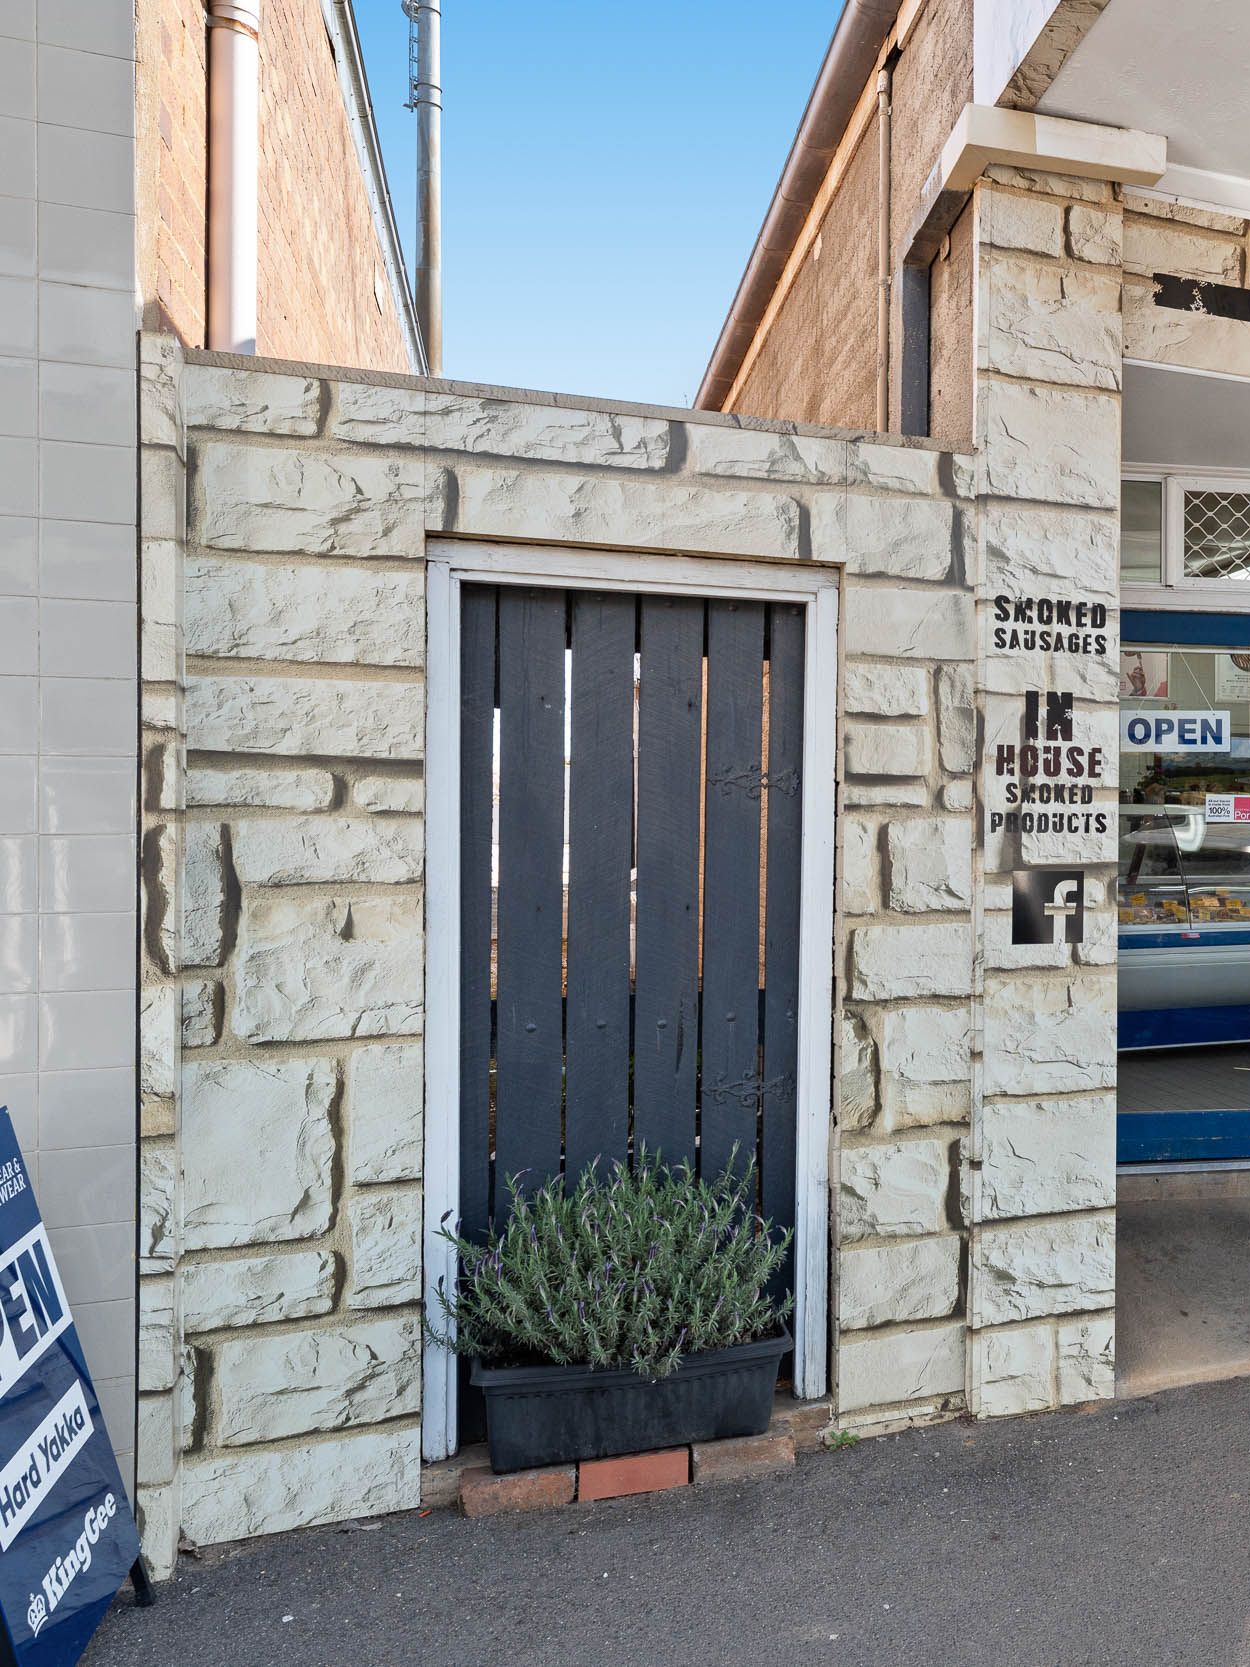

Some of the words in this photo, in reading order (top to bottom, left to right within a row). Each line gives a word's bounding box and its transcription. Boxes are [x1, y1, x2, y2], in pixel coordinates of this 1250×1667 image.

[994, 595, 1107, 629] SMOKED
[994, 628, 1107, 655] SAUSAGES
[1025, 690, 1074, 742] IN
[1127, 717, 1223, 745] OPEN
[995, 744, 1103, 779] HOUSE
[1005, 782, 1093, 805] SMOKED
[990, 812, 1107, 834] PRODUCTS
[1209, 807, 1231, 815] 100%
[13, 1157, 21, 1174] &
[0, 1173, 27, 1206] WEAR
[0, 1238, 64, 1381] EN
[0, 1452, 43, 1528] Hard
[37, 1404, 86, 1474] Yakka
[42, 1492, 117, 1613] KingGee
